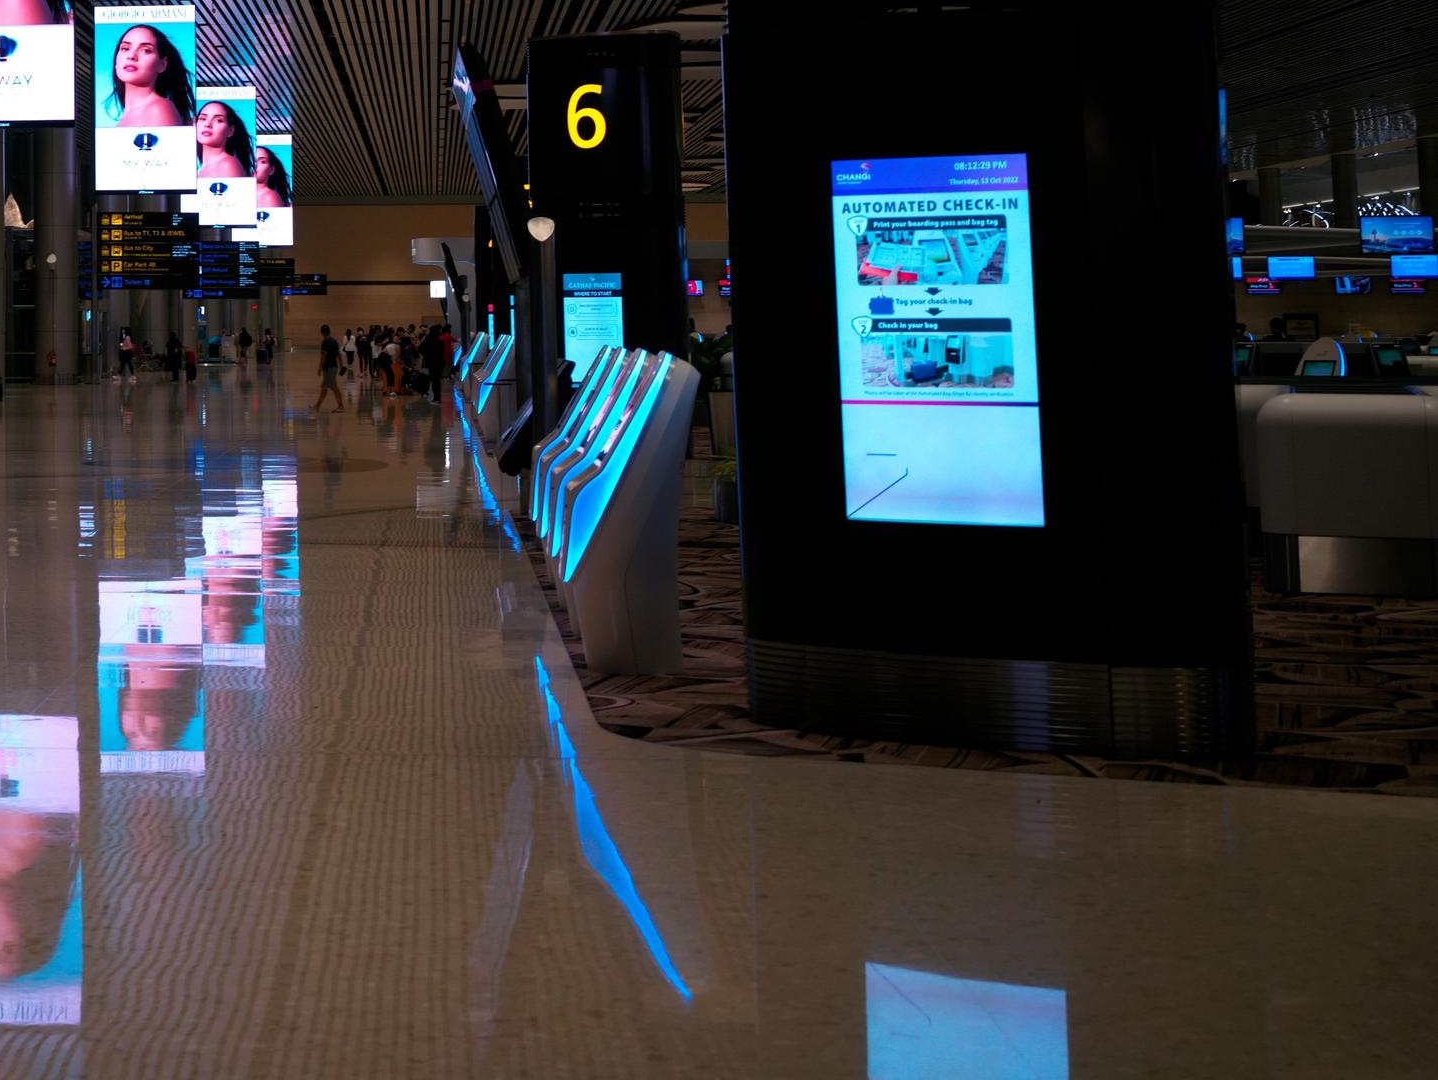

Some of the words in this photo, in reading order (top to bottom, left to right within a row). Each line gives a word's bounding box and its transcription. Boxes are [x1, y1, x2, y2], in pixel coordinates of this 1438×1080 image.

[567, 83, 607, 149] 6
[953, 162, 991, 171] 08:12:29
[992, 161, 1007, 169] PM
[836, 173, 871, 181] CHANGI
[949, 178, 980, 186] Thursday,
[842, 200, 938, 214] AUTOMATED
[943, 197, 1019, 211] CHECK-IN
[856, 224, 861, 234] 1
[891, 221, 907, 229] your
[907, 220, 939, 229] boarding
[940, 220, 956, 228] pass
[971, 219, 985, 227] bag
[986, 219, 999, 227] tag
[896, 298, 909, 306] Tag
[958, 298, 973, 306] bag
[860, 324, 867, 334] 2
[924, 322, 938, 330] bag
